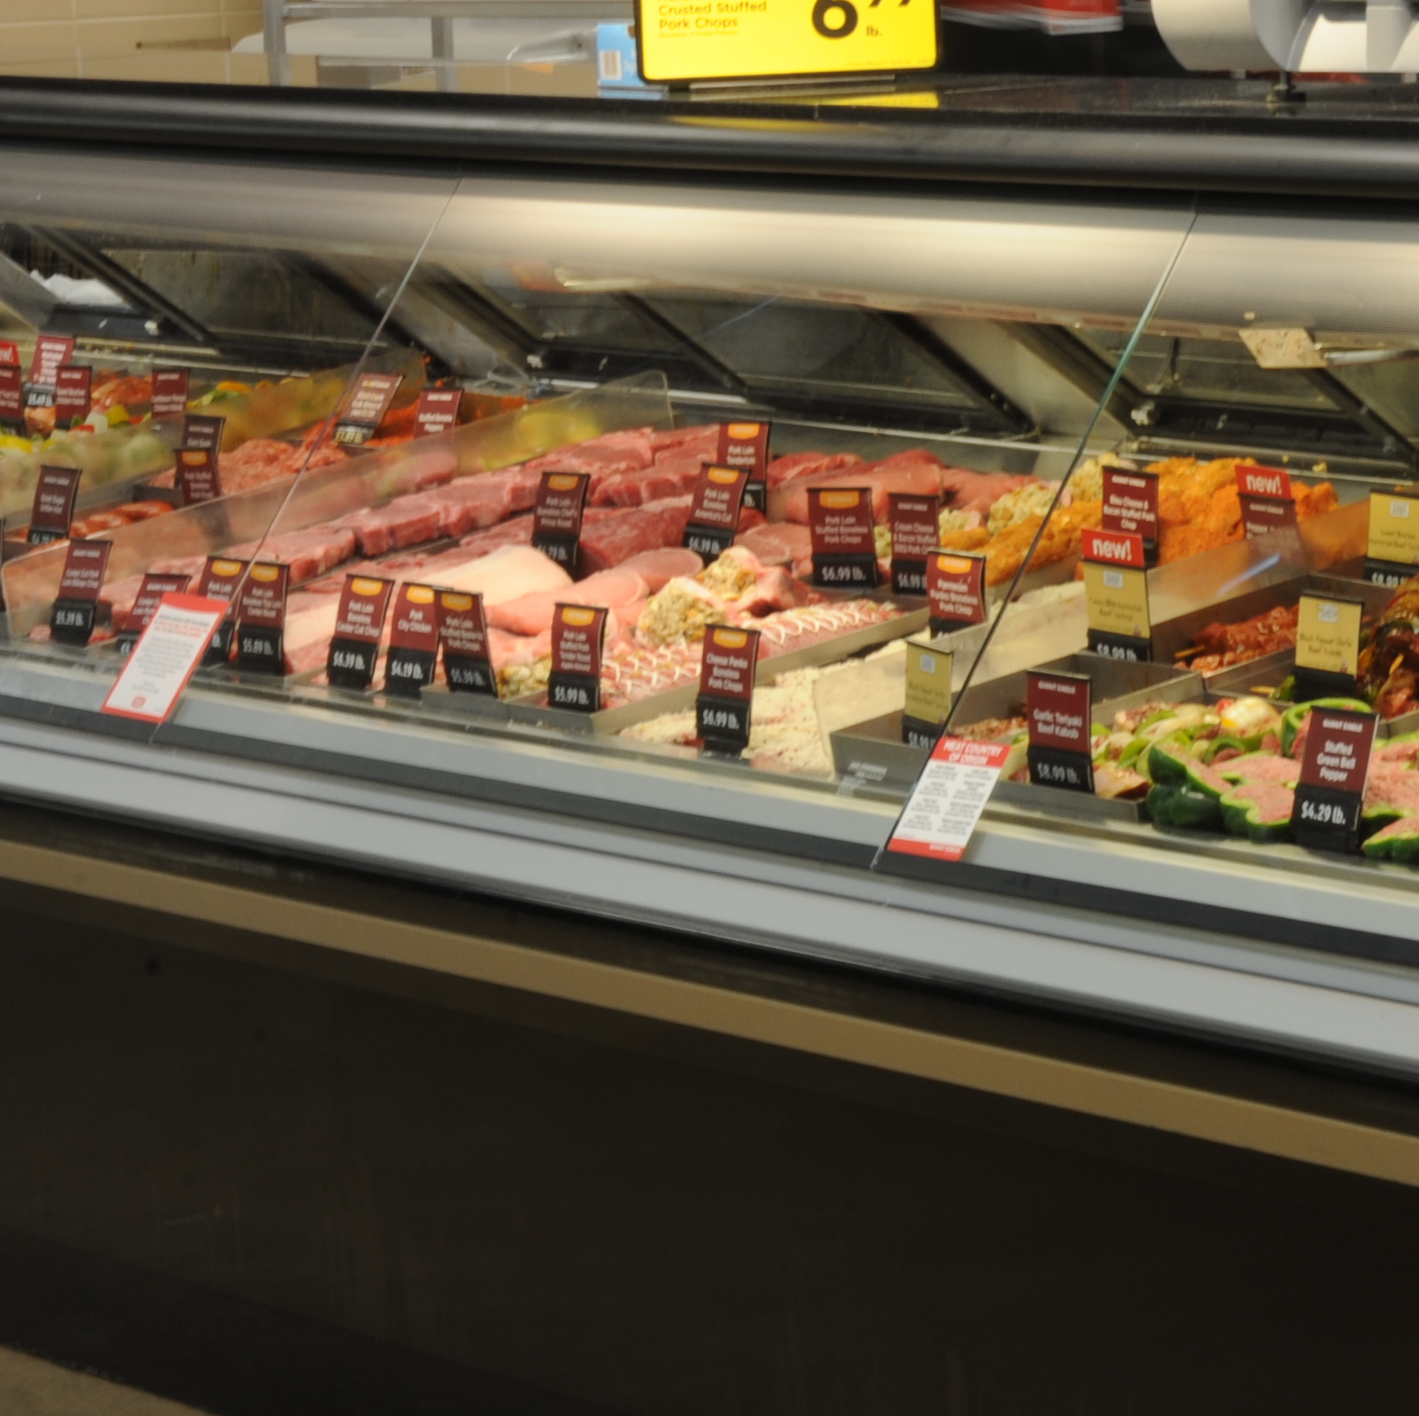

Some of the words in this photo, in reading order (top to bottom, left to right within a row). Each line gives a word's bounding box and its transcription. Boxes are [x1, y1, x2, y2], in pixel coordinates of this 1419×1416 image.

[658, 4, 712, 16] Crusted
[716, 1, 767, 13] Stuffed
[659, 19, 689, 30] Pork
[695, 17, 738, 30] Chops
[866, 26, 883, 37] lb.
[1246, 474, 1282, 495] new!
[1093, 539, 1132, 561] new!
[943, 738, 965, 753] MEAT
[966, 742, 1004, 757] COUNTRY
[949, 751, 960, 762] OF
[960, 753, 989, 766] ORIGIN
[1301, 800, 1332, 822] $4.29
[1332, 806, 1346, 825] lb.
